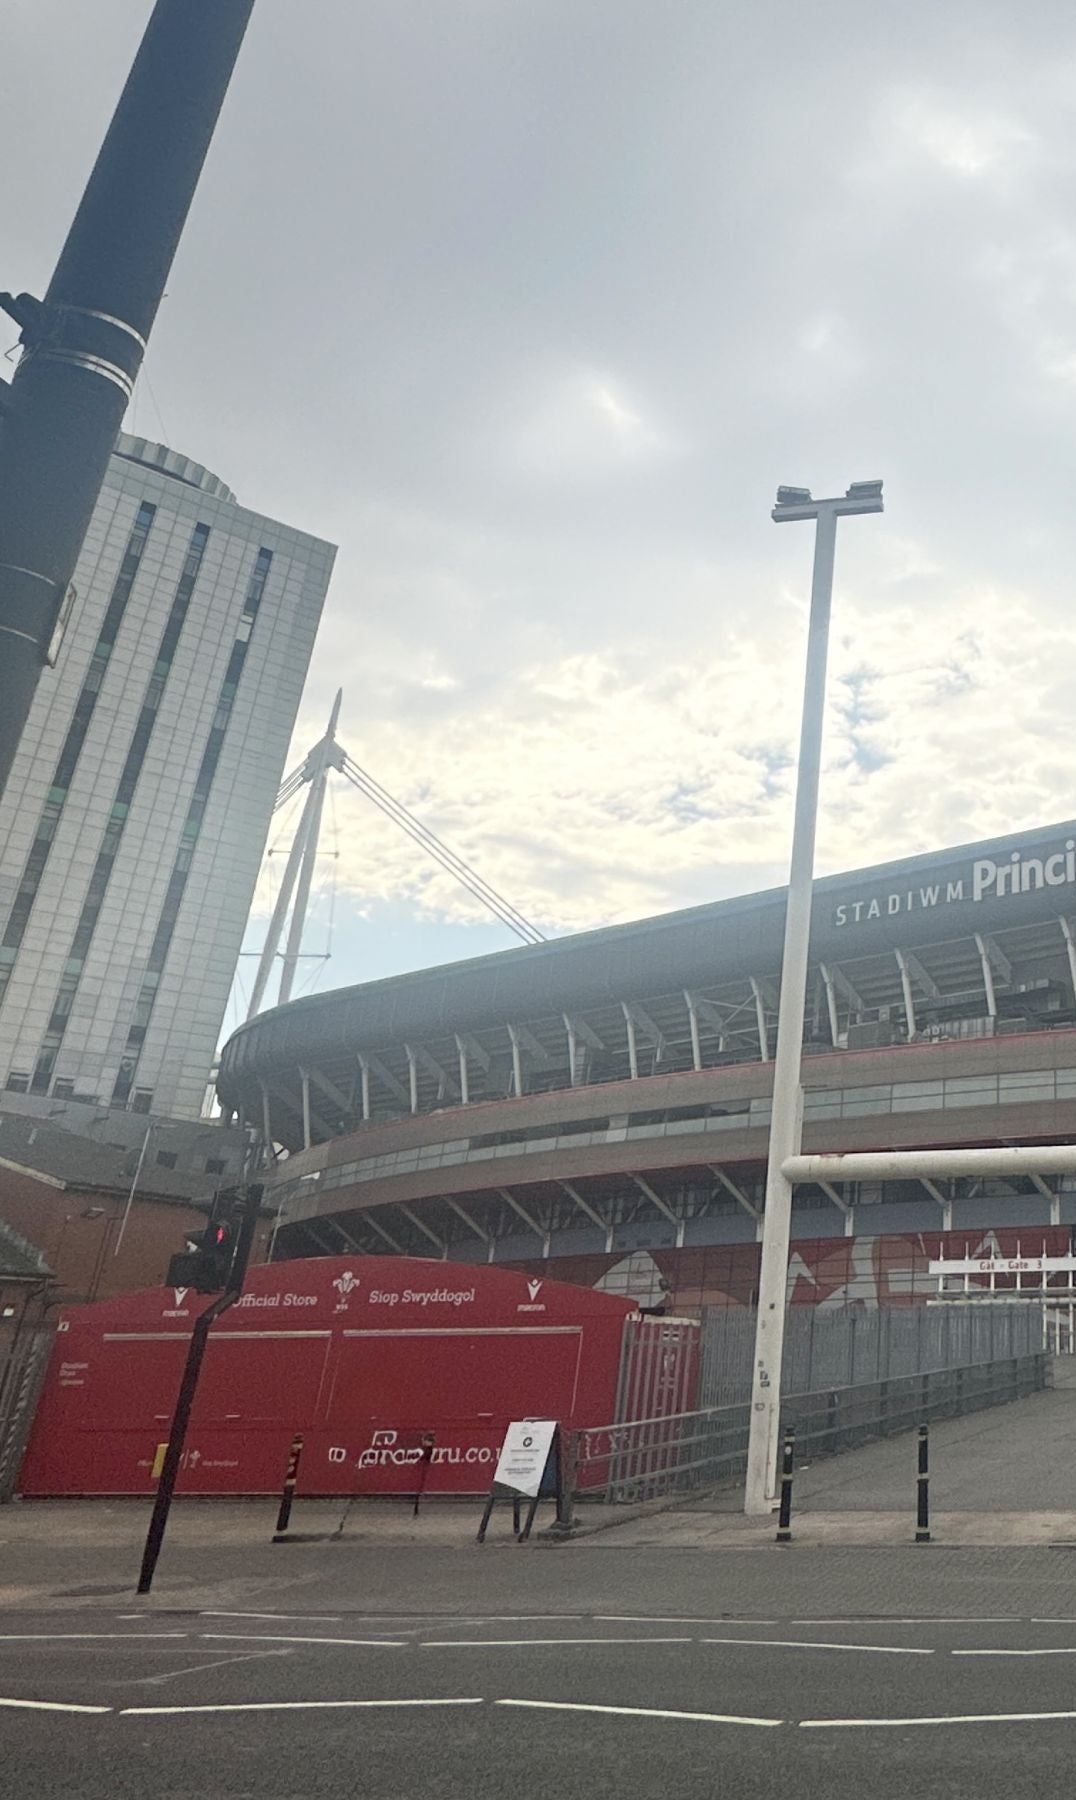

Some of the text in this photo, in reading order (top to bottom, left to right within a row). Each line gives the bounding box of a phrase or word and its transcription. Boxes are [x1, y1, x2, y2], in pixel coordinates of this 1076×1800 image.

[835, 878, 965, 927] STADIWM
[1008, 1260, 1029, 1270] Gate
[1036, 1259, 1043, 1269] 3
[283, 1293, 319, 1306] Store
[368, 1288, 476, 1306] Siop Swyddogol
